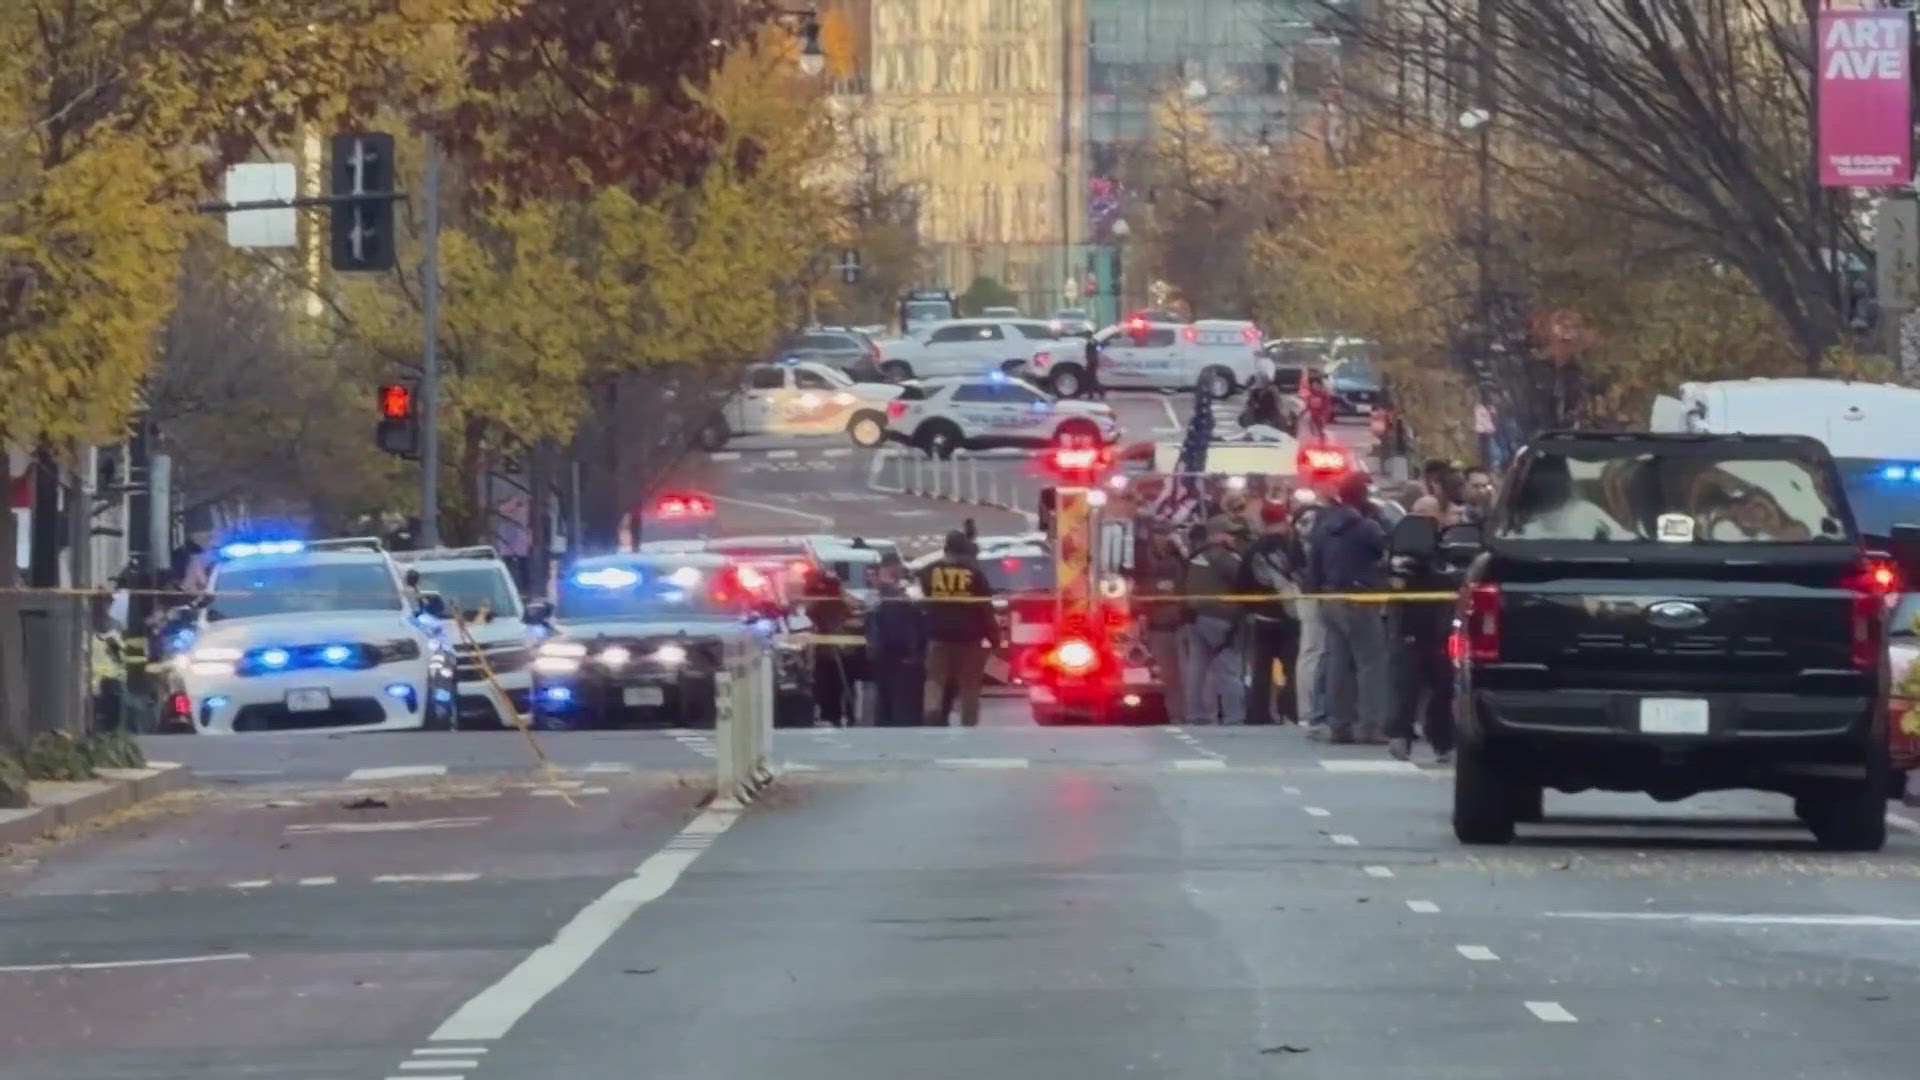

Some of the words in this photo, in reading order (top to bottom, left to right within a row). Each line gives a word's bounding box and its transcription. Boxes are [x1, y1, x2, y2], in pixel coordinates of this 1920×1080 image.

[1825, 19, 1904, 48] ART
[1825, 51, 1901, 79] AVE
[931, 567, 973, 592] ATF
